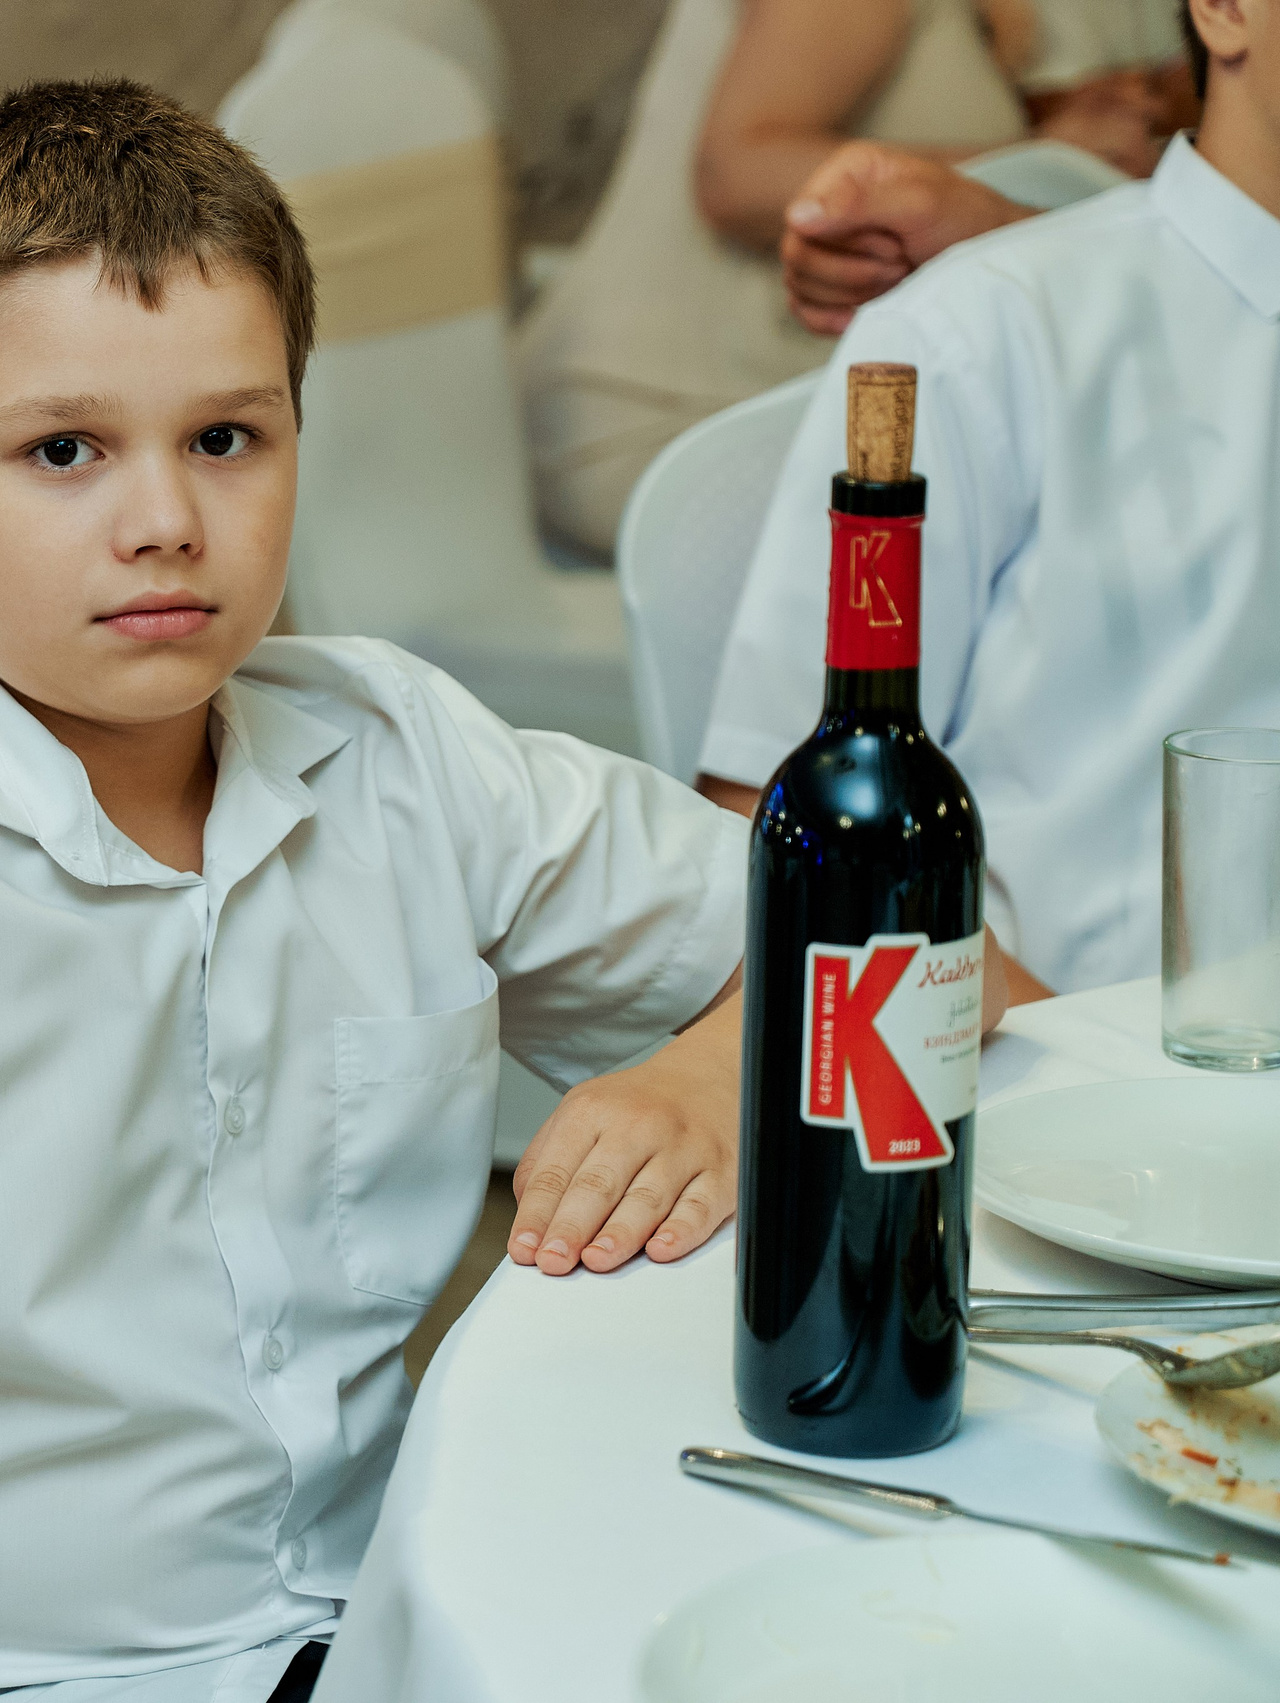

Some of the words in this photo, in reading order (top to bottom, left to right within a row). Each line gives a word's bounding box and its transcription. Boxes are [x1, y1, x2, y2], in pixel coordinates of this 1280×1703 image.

[849, 531, 903, 627] K
[821, 973, 837, 1016] WINE
[809, 944, 948, 1163] K
[818, 1019, 835, 1106] GEORGIAN
